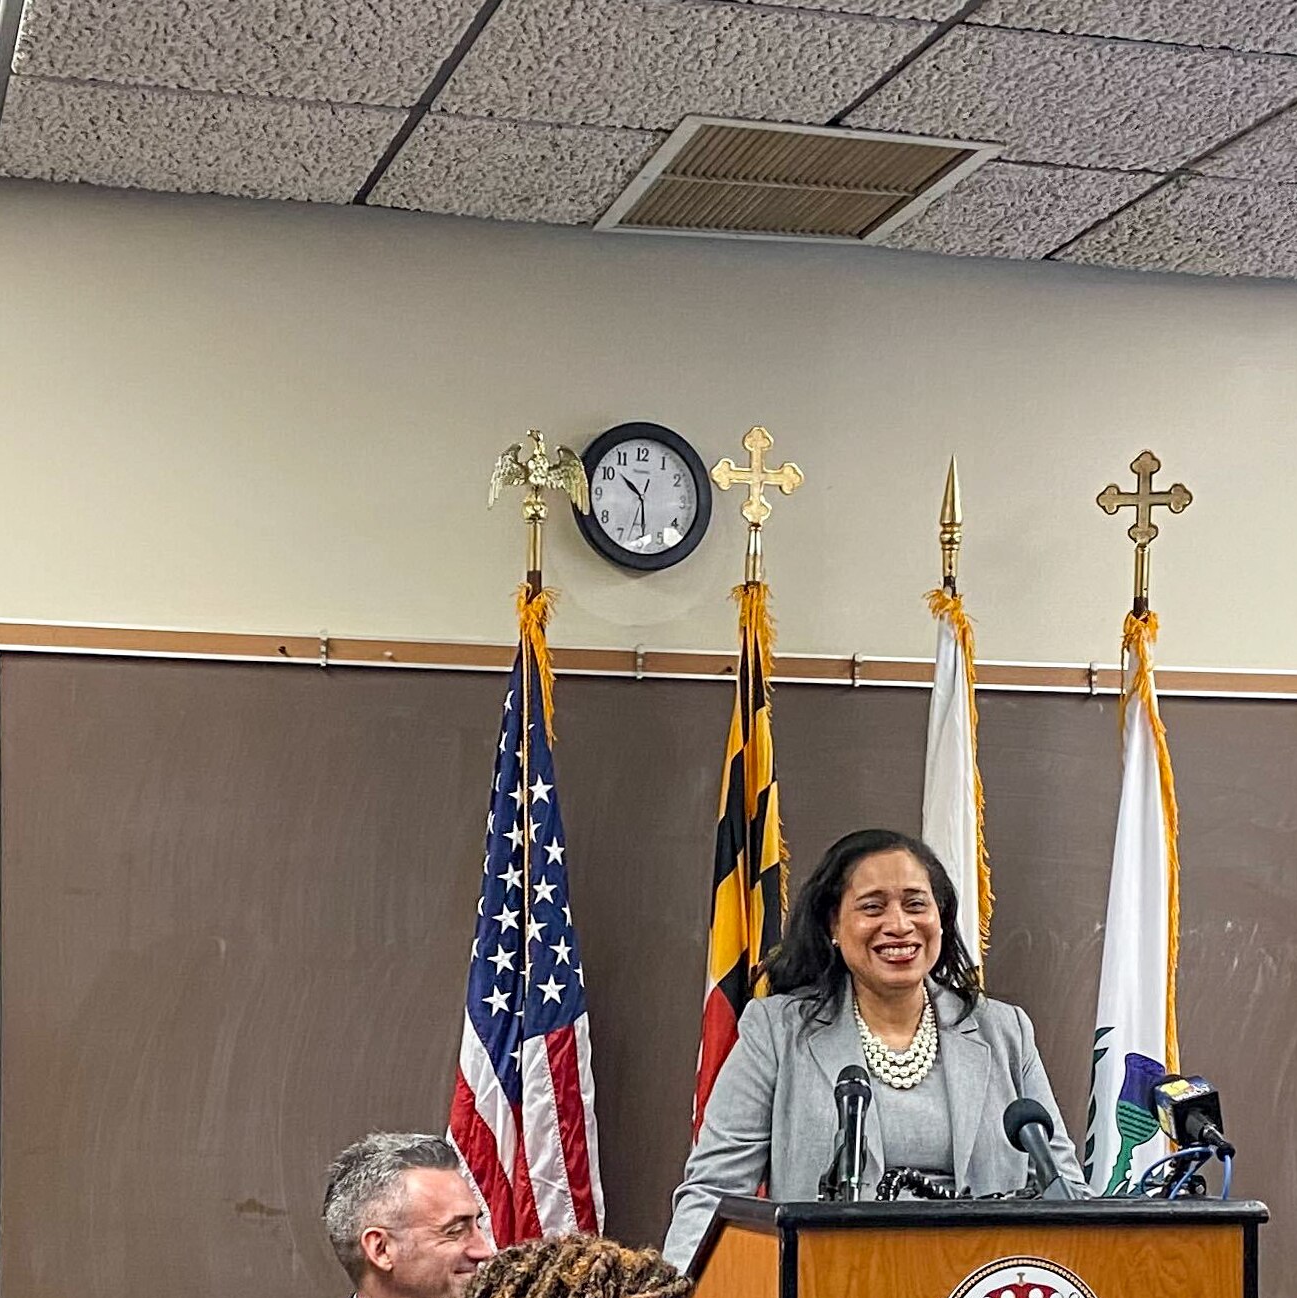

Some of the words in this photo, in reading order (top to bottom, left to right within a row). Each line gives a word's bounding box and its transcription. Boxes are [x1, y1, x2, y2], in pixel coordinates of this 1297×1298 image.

[617, 451, 627, 466] 11
[636, 448, 649, 462] 12
[660, 456, 666, 470] 1
[602, 466, 615, 480] 10
[673, 474, 682, 487] 2
[595, 487, 603, 500] 9
[679, 496, 687, 509] 3
[601, 510, 609, 524] 8
[671, 517, 679, 529] 4
[617, 527, 625, 541] 7
[656, 532, 664, 545] 5
